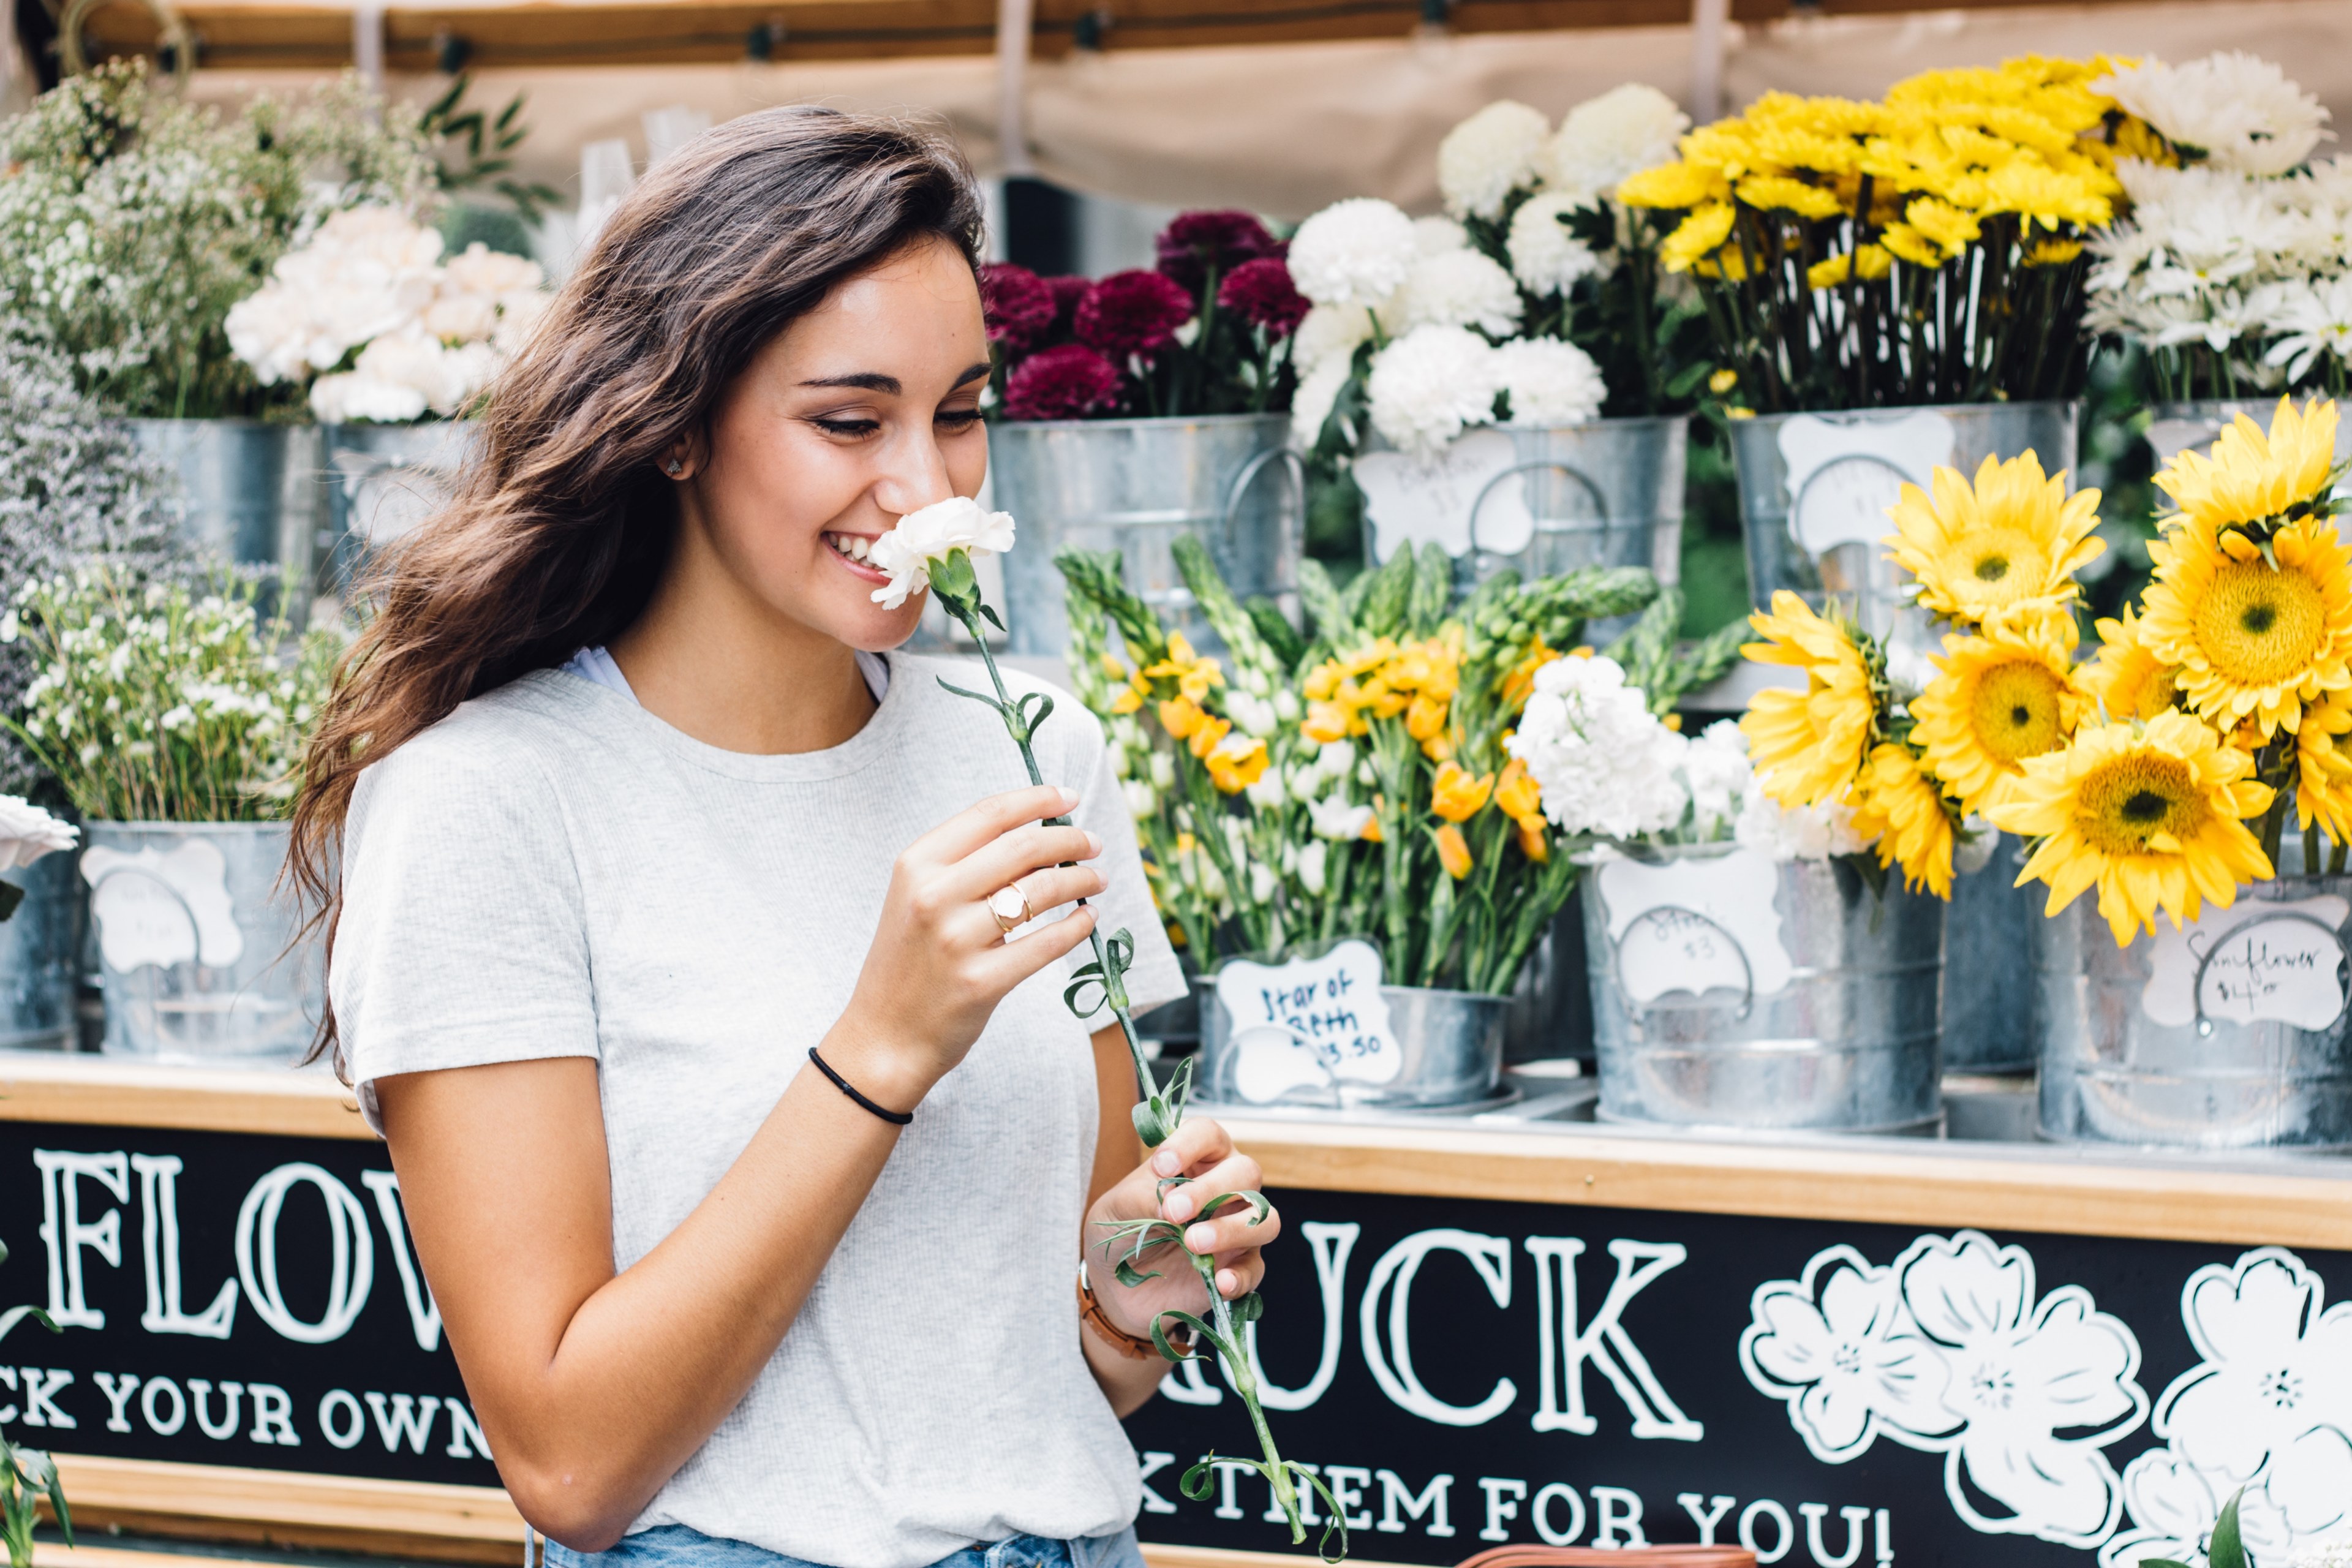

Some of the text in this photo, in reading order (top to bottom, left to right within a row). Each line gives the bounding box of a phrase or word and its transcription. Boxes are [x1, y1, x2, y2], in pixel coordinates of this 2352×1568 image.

[1261, 968, 1354, 1022] Star of
[92, 1371, 301, 1447] YOUR
[1198, 1454, 1456, 1538] THEM
[1477, 1476, 1652, 1551] FOR
[1676, 1492, 1895, 1568] YOU!
